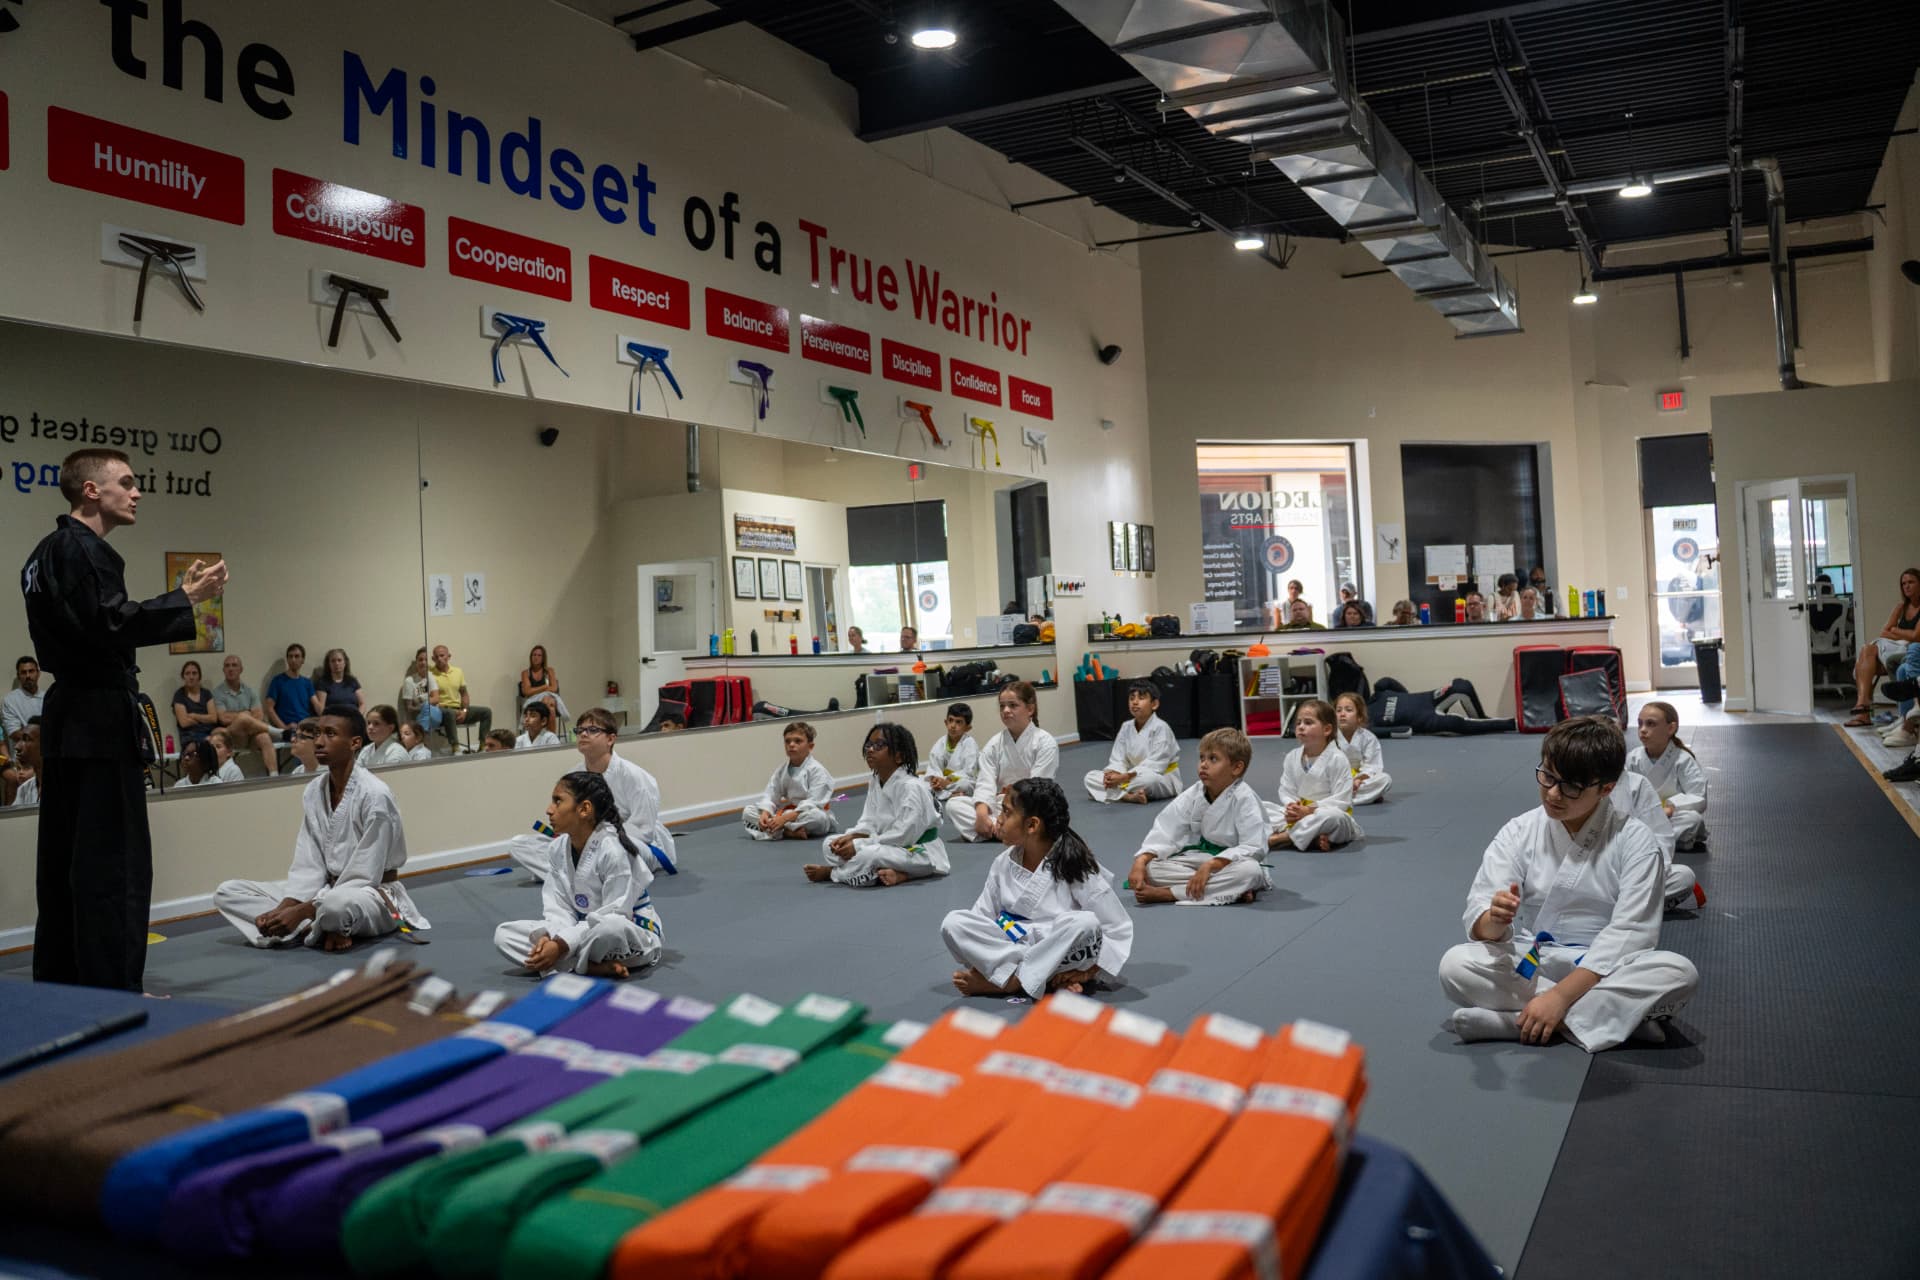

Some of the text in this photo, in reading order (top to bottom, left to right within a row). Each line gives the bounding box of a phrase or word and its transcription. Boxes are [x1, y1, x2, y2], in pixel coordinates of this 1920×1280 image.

[94, 142, 206, 199] Humility
[99, 0, 1032, 356] the Mindset of a True Warrior
[286, 193, 414, 246] Composure
[455, 237, 566, 283] Cooperation
[611, 277, 671, 310] Respect
[723, 307, 774, 336] Balance
[802, 330, 869, 361] Perseverance
[892, 353, 932, 377] Discipline
[954, 370, 998, 395] Confidence
[1021, 389, 1041, 407] Focus
[1662, 392, 1682, 409] EXIT
